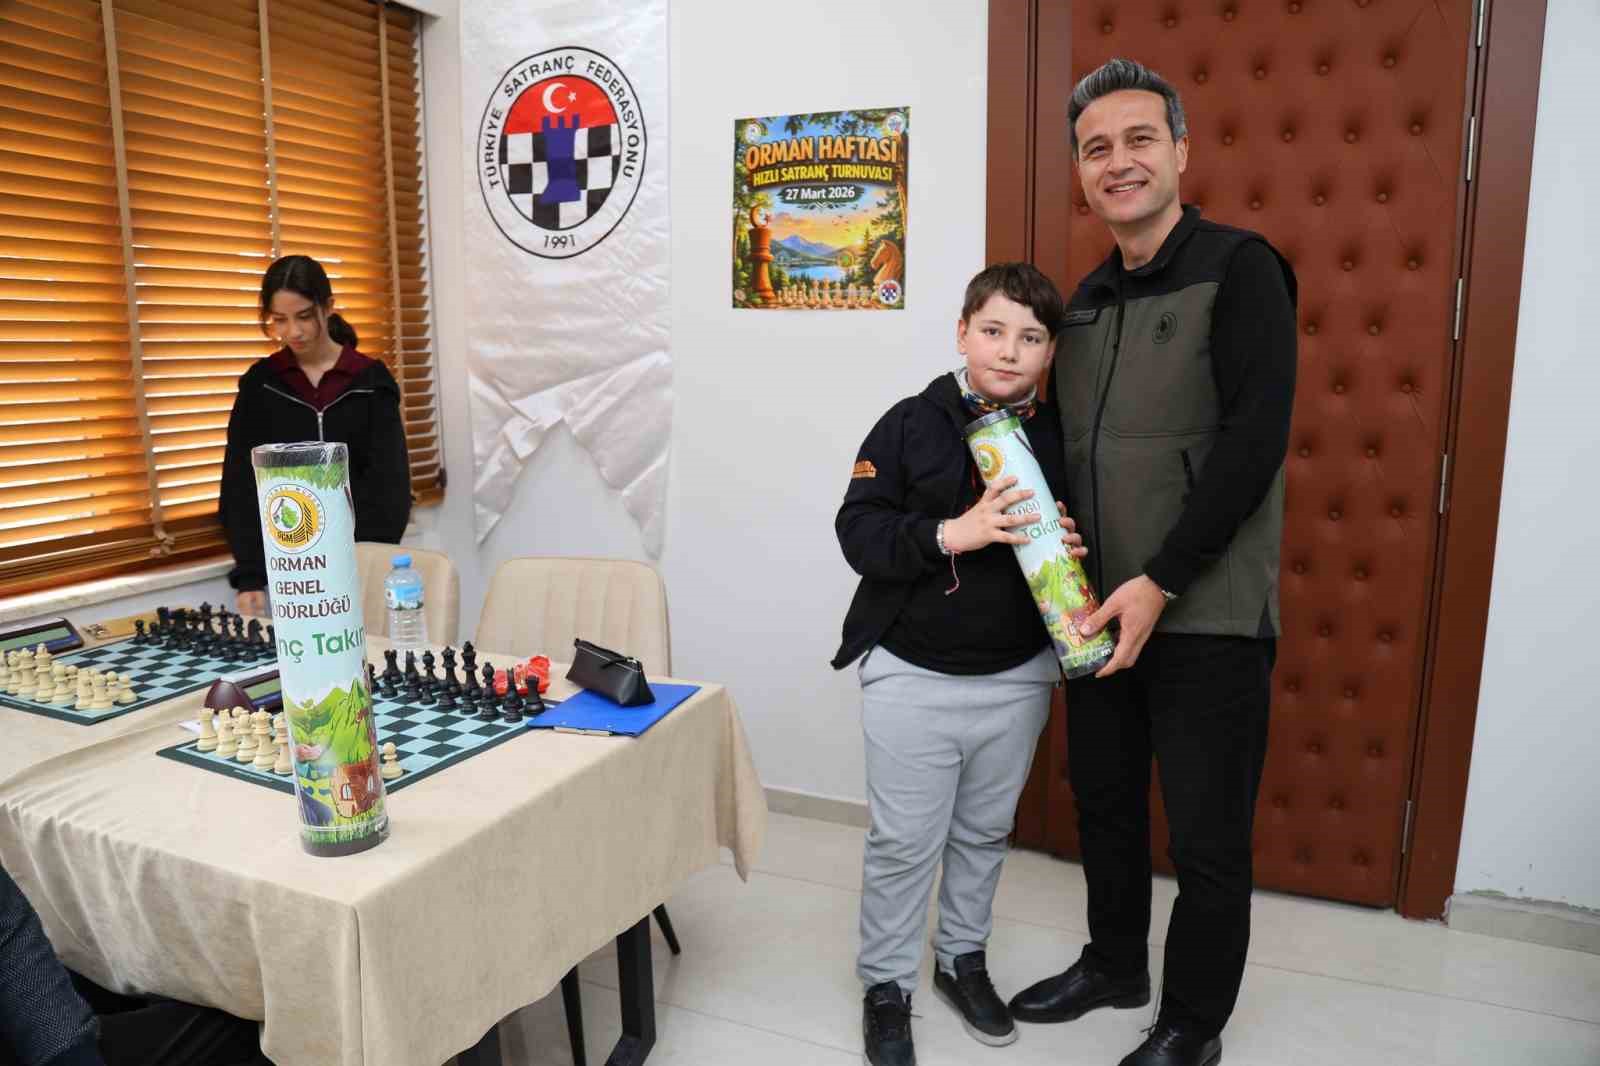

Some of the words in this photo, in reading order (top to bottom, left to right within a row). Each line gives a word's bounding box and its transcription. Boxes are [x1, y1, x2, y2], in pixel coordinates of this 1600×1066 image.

[503, 56, 575, 98] SATRANÇ
[586, 60, 640, 178] FEDERASYONU
[745, 136, 813, 170] ORMAN
[753, 168, 779, 187] HIZLI
[780, 164, 830, 182] SATRANÇ
[831, 164, 893, 182] TURNUVASI
[785, 188, 799, 200] 27
[800, 187, 827, 200] Mart
[828, 186, 855, 198] 2026
[543, 234, 576, 249] 1991
[270, 554, 327, 572] ORMAN
[275, 579, 325, 595] GENEL
[272, 594, 351, 619] ÜDÜRLÜĞÜ
